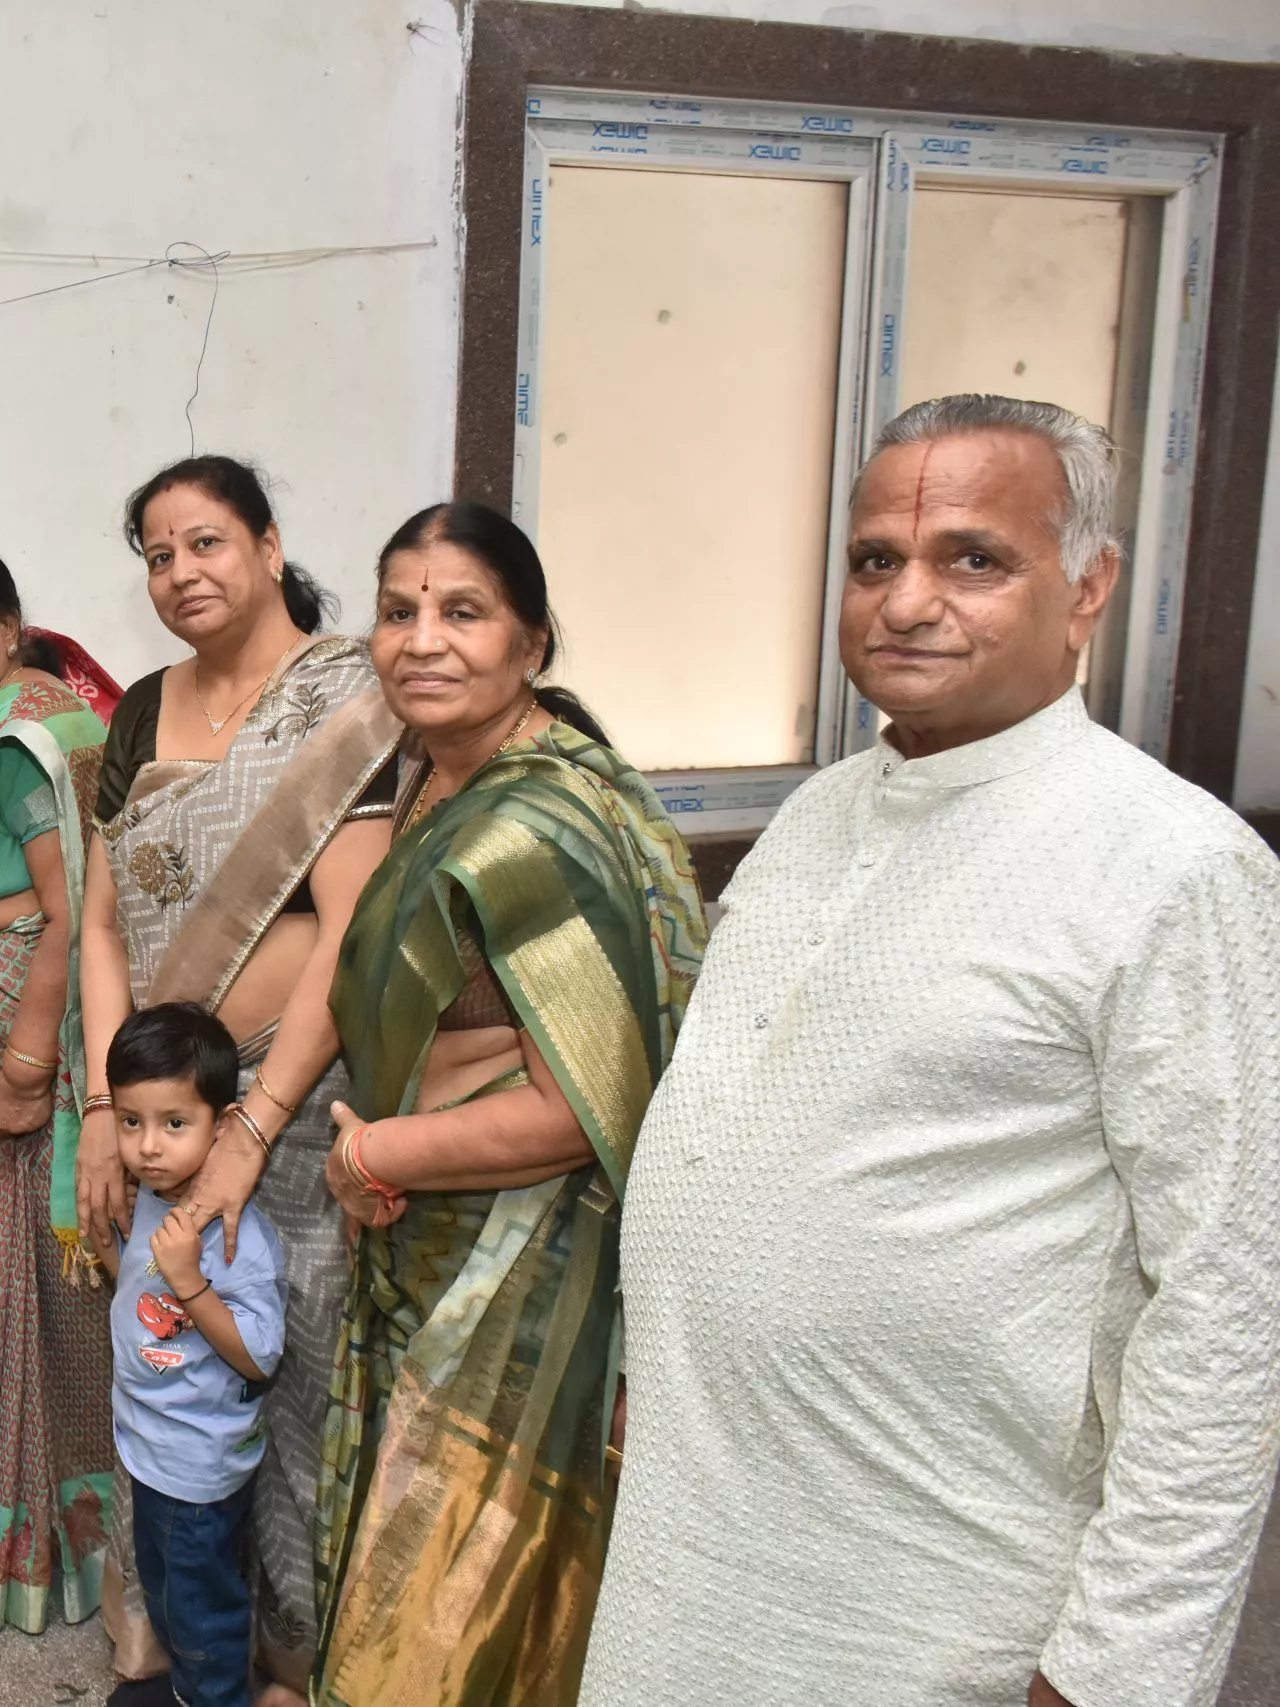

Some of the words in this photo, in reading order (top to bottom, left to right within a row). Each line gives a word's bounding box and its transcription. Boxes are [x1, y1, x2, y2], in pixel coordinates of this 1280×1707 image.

[591, 122, 649, 140] DIMEX
[800, 116, 855, 133] DIMEX
[747, 144, 802, 161] DIMEX
[921, 138, 972, 154] DIMEX
[1058, 159, 1109, 175] DIMEX
[880, 313, 895, 377] DIMEX
[517, 373, 531, 427] DIME
